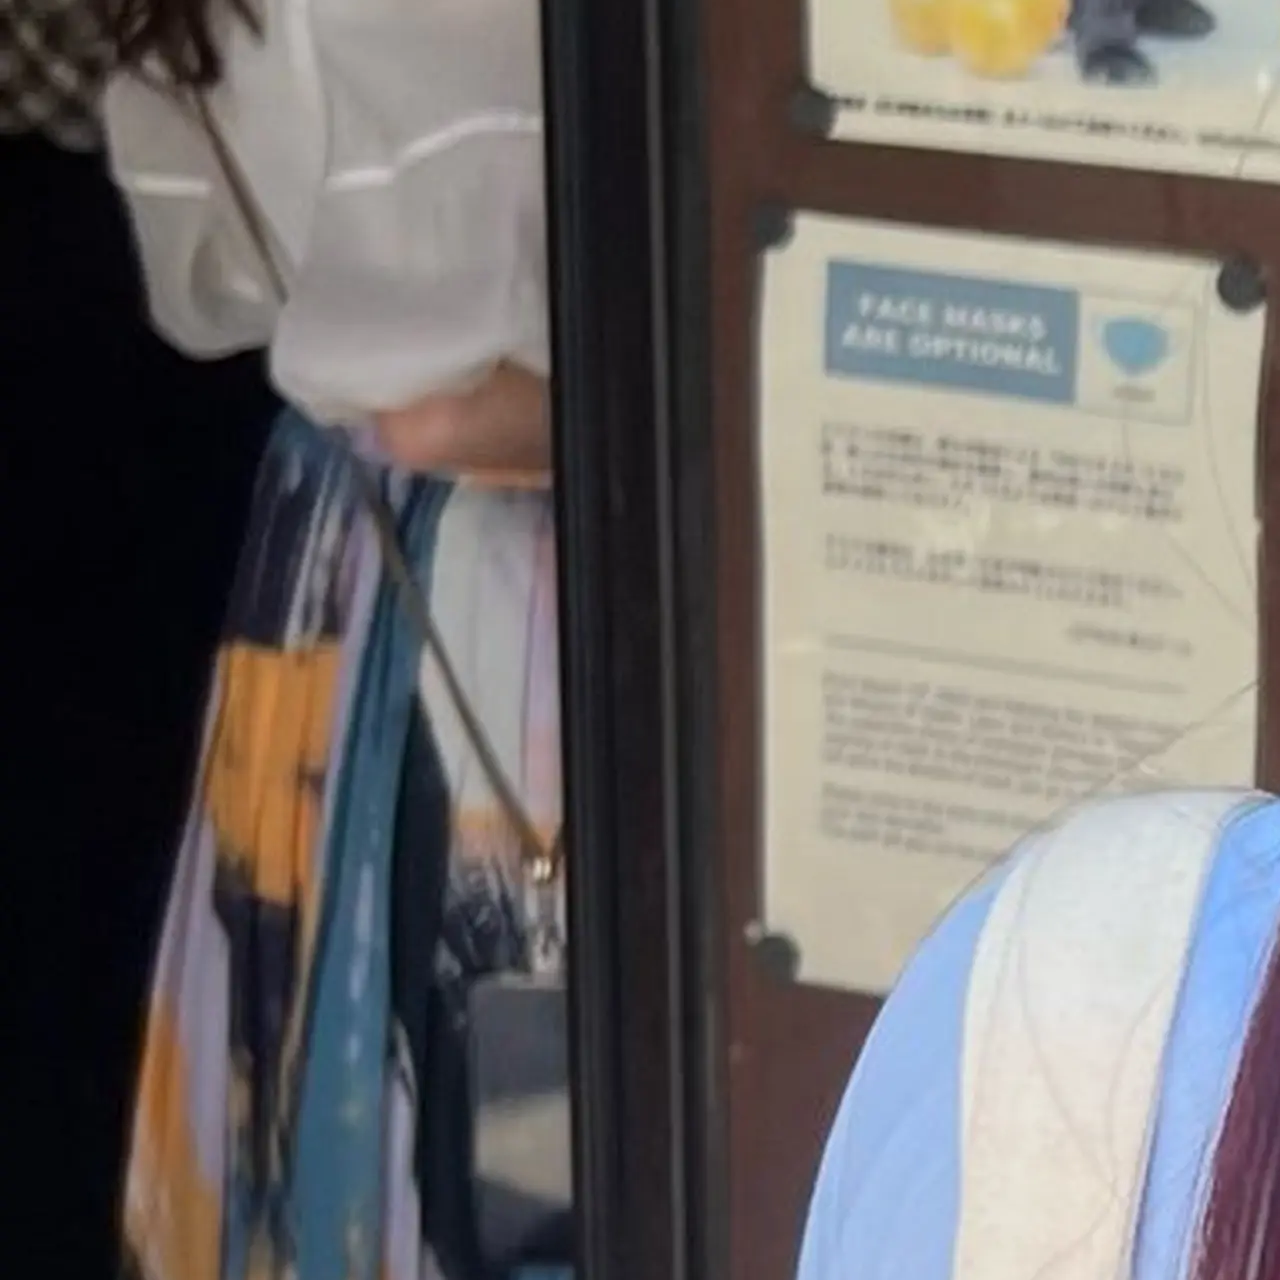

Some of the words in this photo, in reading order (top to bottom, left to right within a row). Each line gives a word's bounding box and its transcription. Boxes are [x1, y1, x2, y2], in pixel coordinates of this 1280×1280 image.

[858, 293, 932, 323] FACE
[944, 304, 1048, 340] MASKS
[842, 323, 897, 353] ARE
[908, 334, 1062, 377] OPTIONAL
